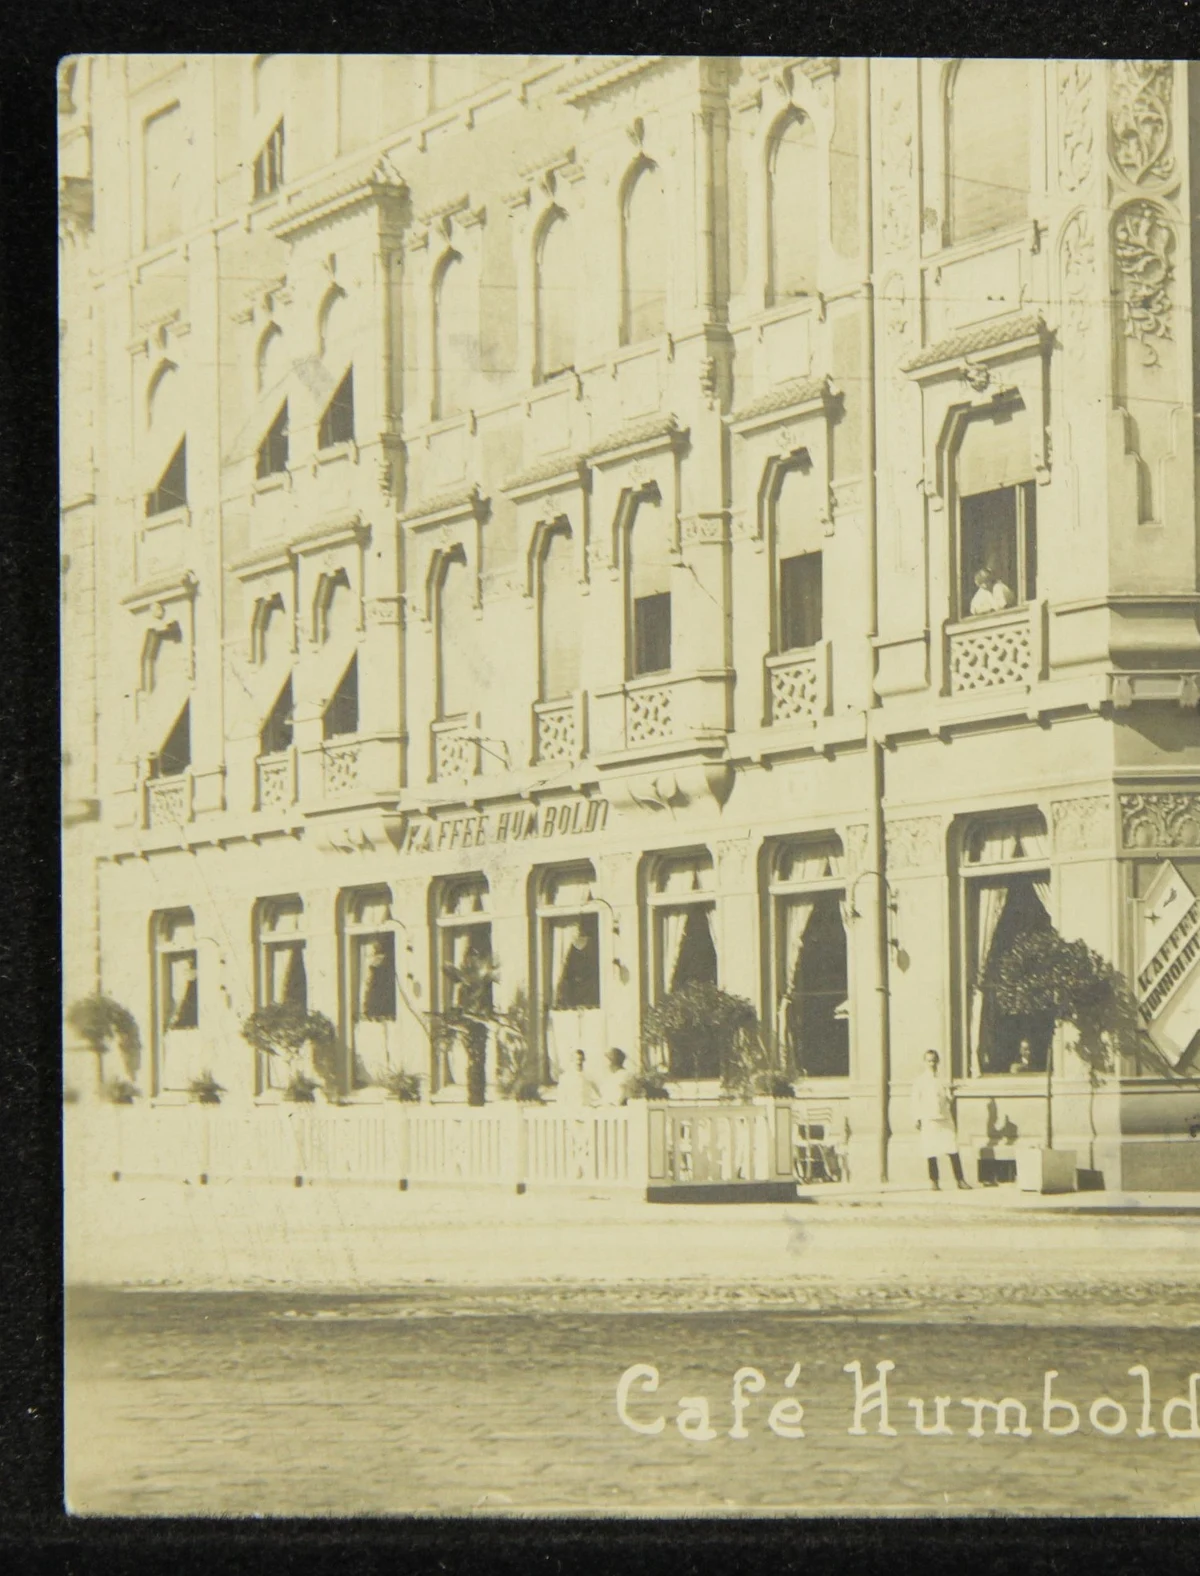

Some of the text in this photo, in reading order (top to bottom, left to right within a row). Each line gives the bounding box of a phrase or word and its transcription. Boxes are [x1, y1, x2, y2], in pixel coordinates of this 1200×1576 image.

[404, 799, 609, 855] KAFFEE HUMBOLDT
[1136, 902, 1200, 992] KAFFEE
